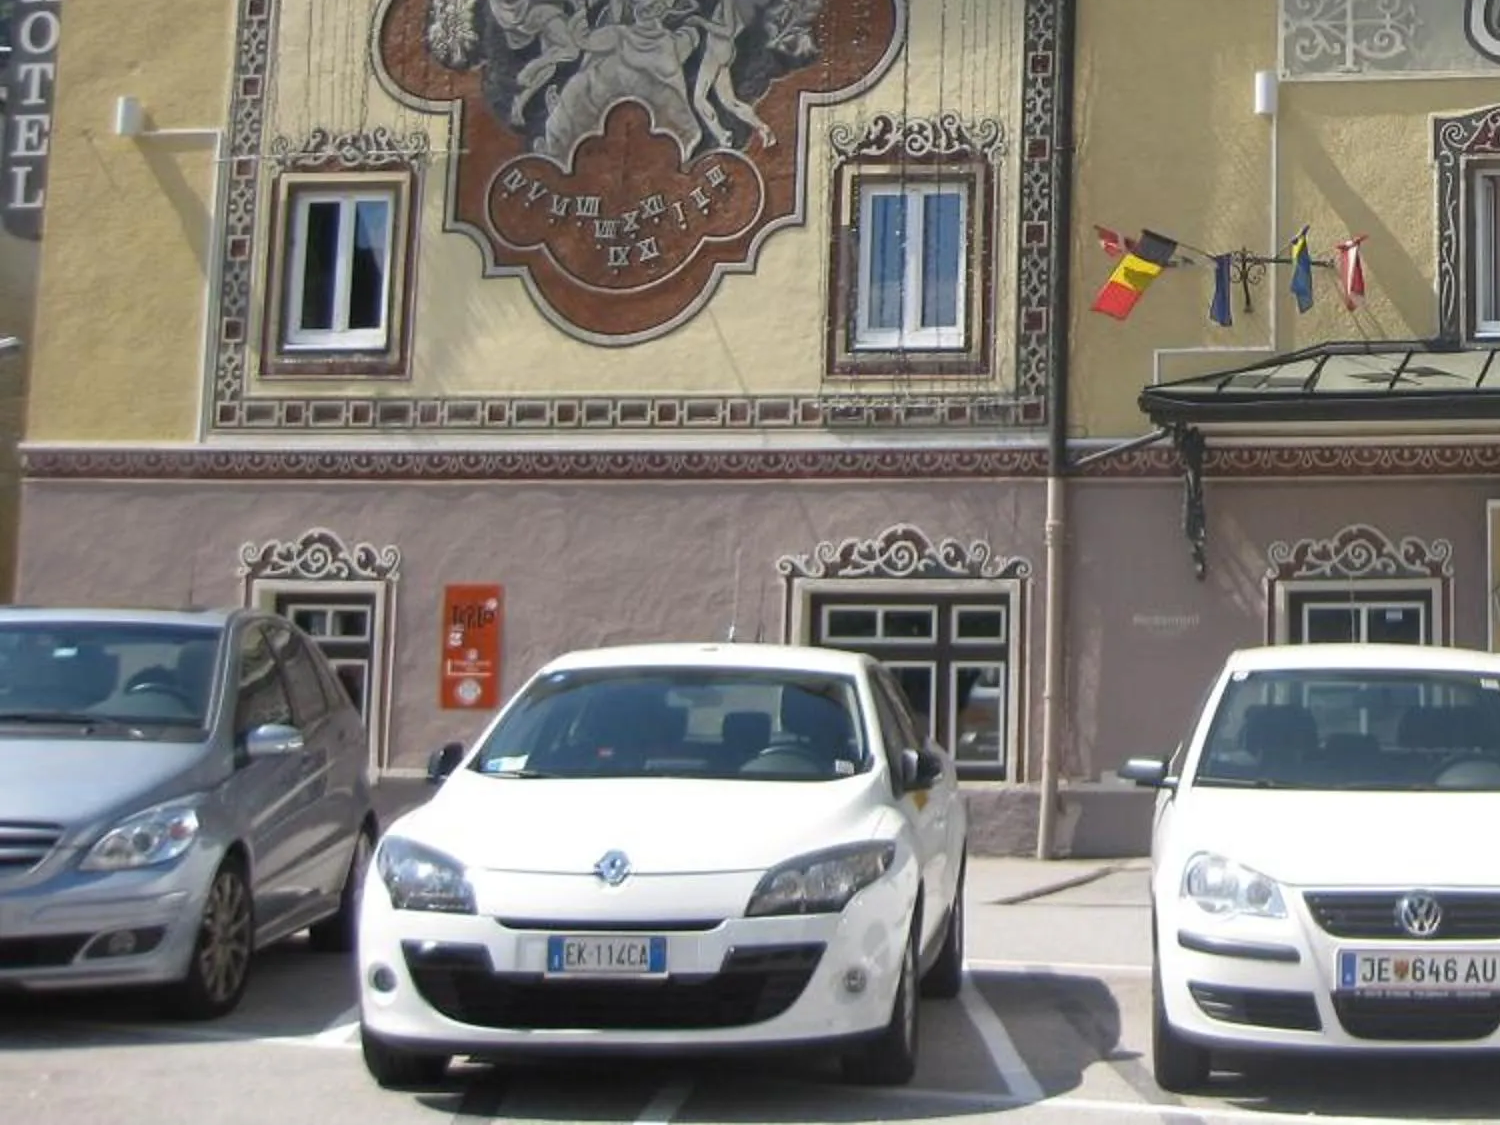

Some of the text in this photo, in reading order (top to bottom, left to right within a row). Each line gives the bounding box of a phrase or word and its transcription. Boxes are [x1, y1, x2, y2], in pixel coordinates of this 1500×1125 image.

[566, 943, 586, 965] EK
[1361, 958, 1496, 983] JE 646 AU
